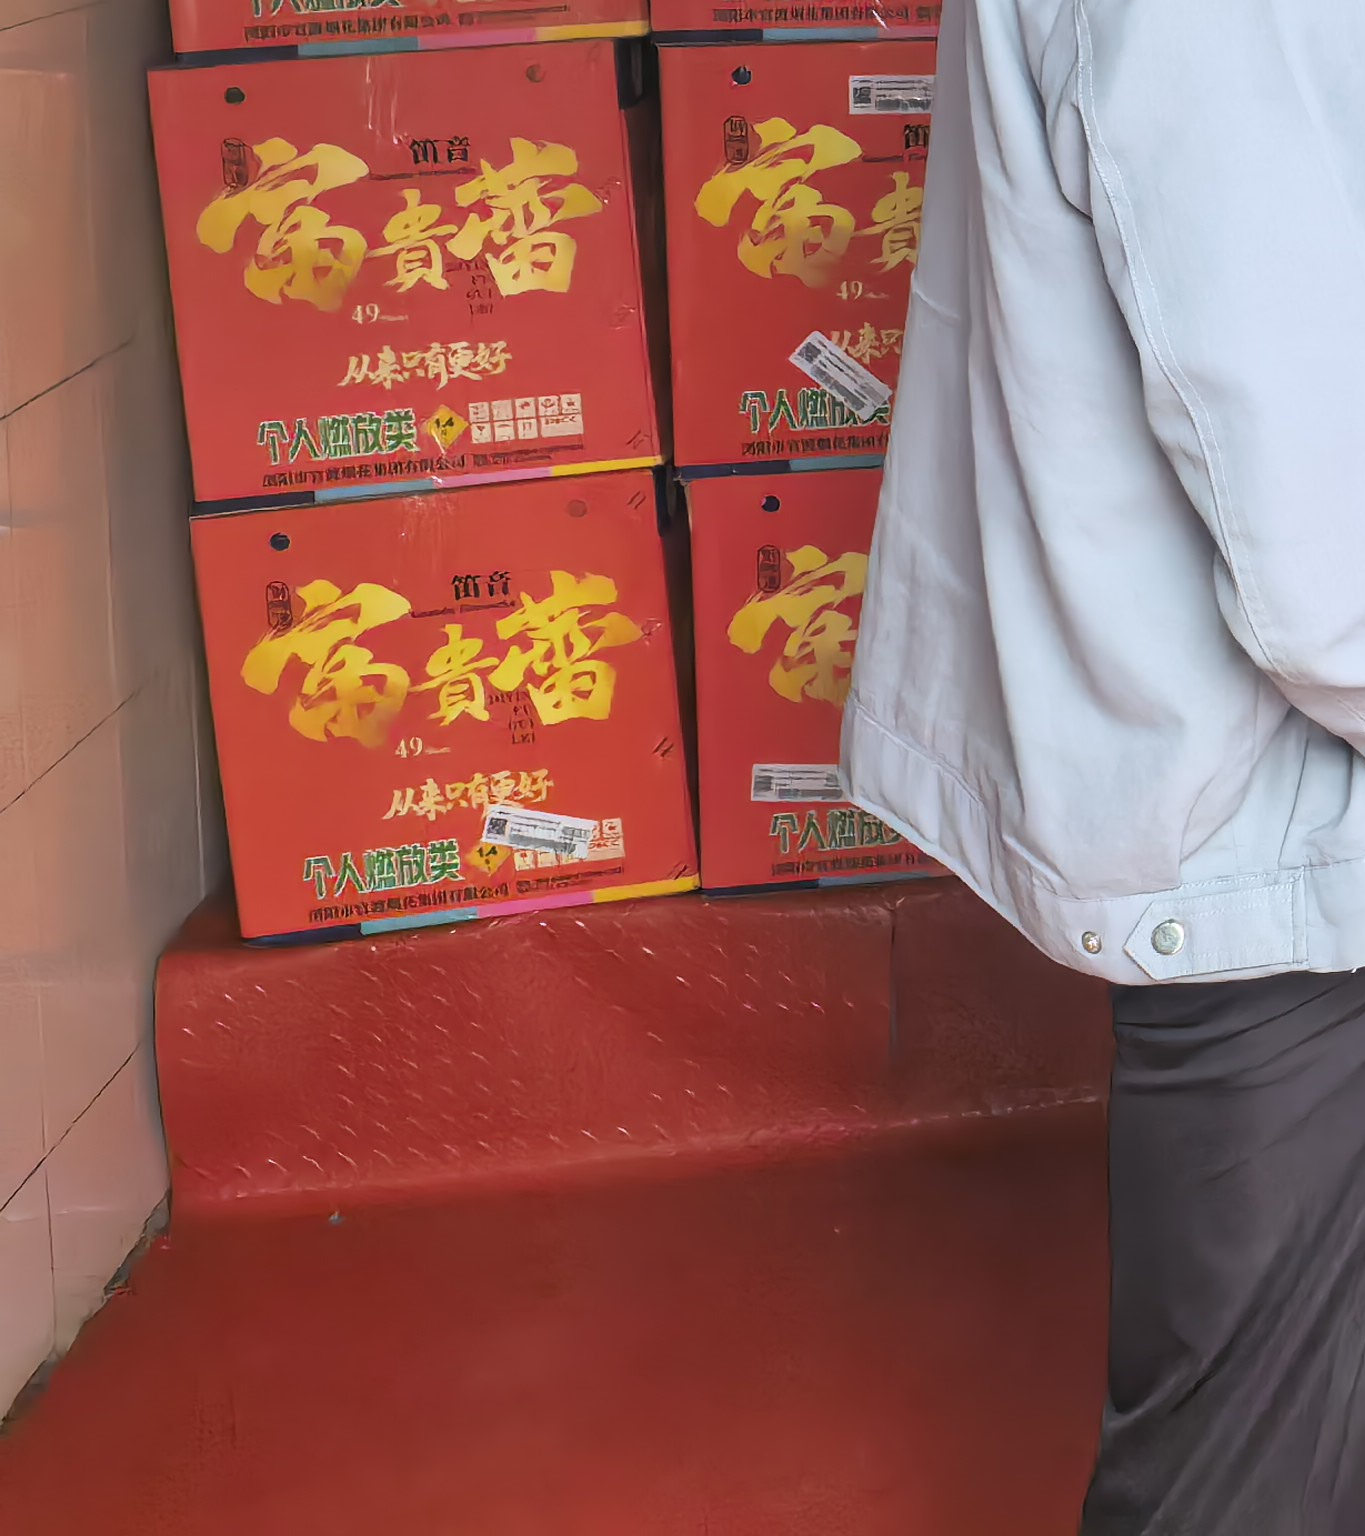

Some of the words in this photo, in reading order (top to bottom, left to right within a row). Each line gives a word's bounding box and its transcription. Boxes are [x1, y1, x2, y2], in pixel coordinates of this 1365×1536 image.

[338, 341, 513, 390] 从来只有更好
[257, 408, 420, 465] 个人燃放类
[395, 737, 423, 758] 49
[383, 769, 554, 821] 从来只有更好
[304, 838, 463, 900] 个人燃放类
